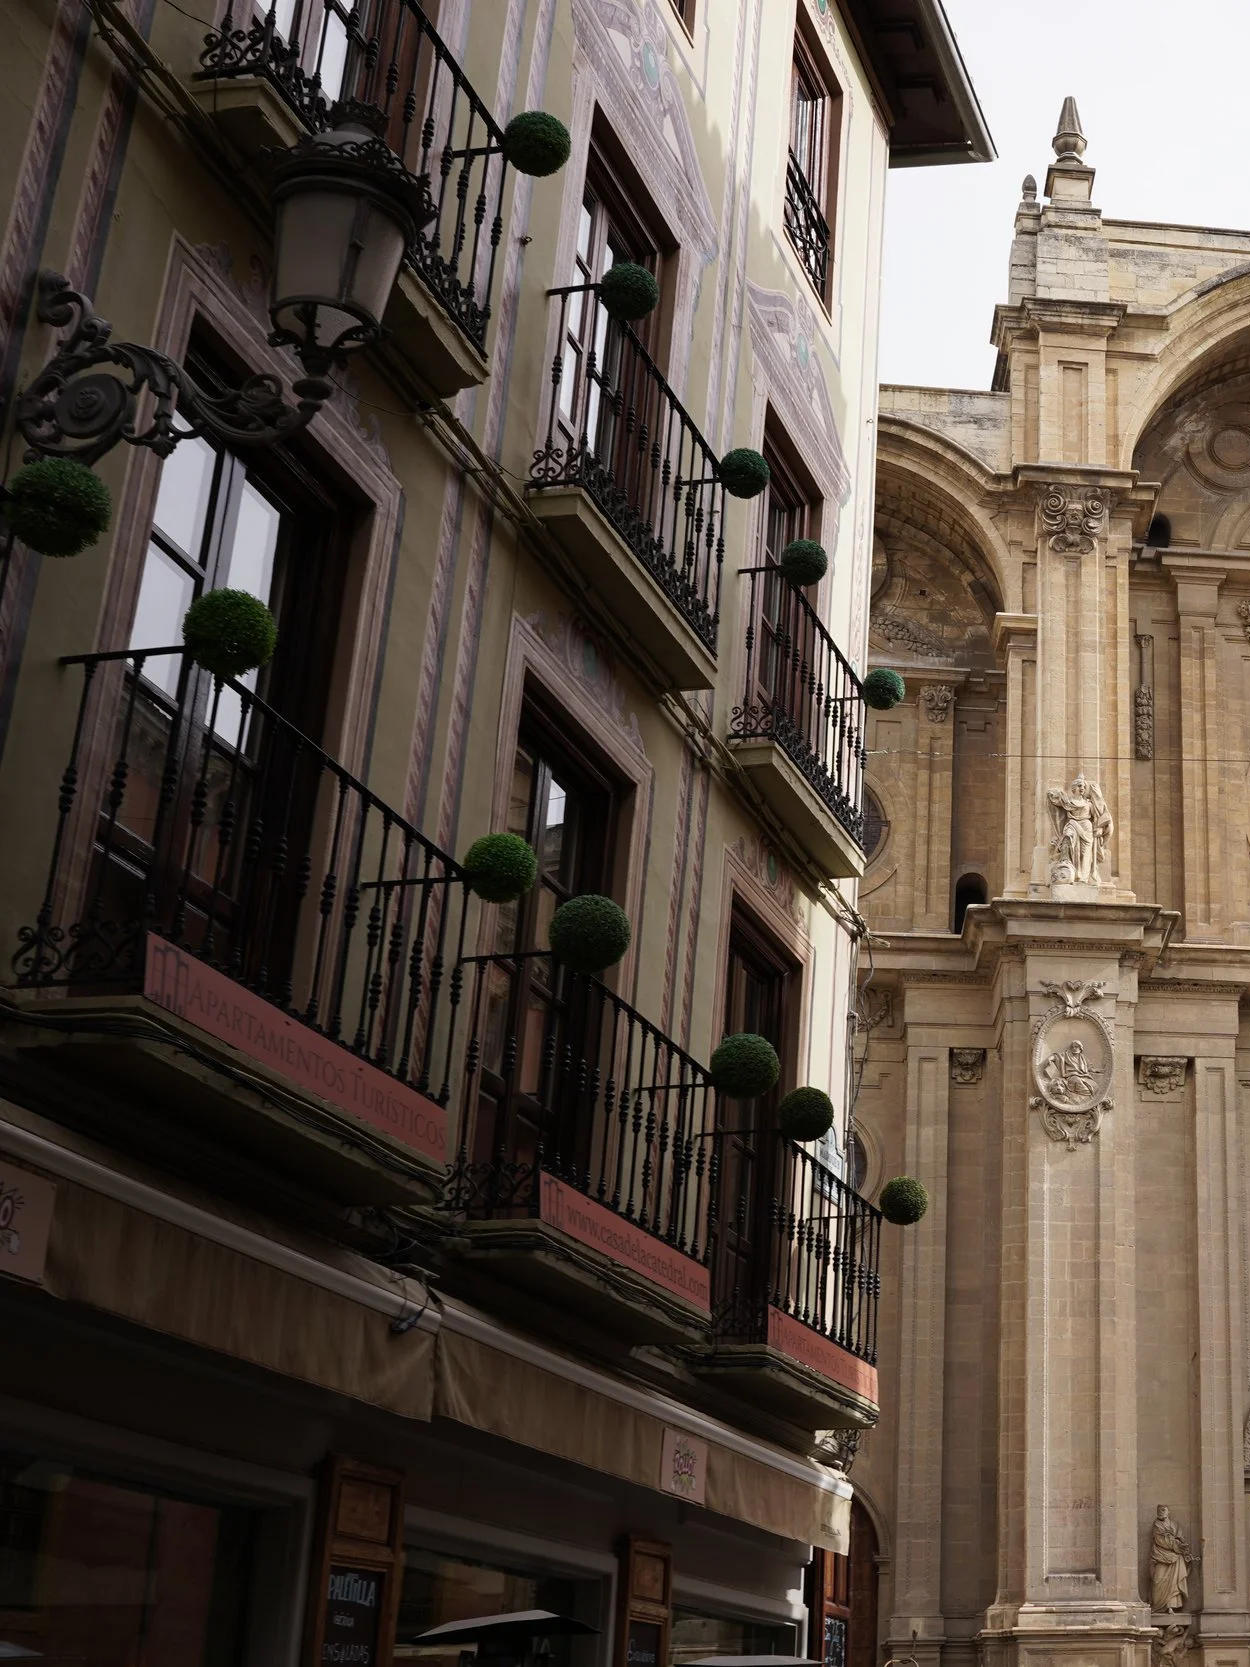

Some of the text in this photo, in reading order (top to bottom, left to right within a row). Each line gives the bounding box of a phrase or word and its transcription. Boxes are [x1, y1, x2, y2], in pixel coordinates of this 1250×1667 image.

[188, 982, 446, 1150] APARTAMENTOS TURÍSTICOS
[566, 1205, 708, 1300] www.casadelacatedral.com
